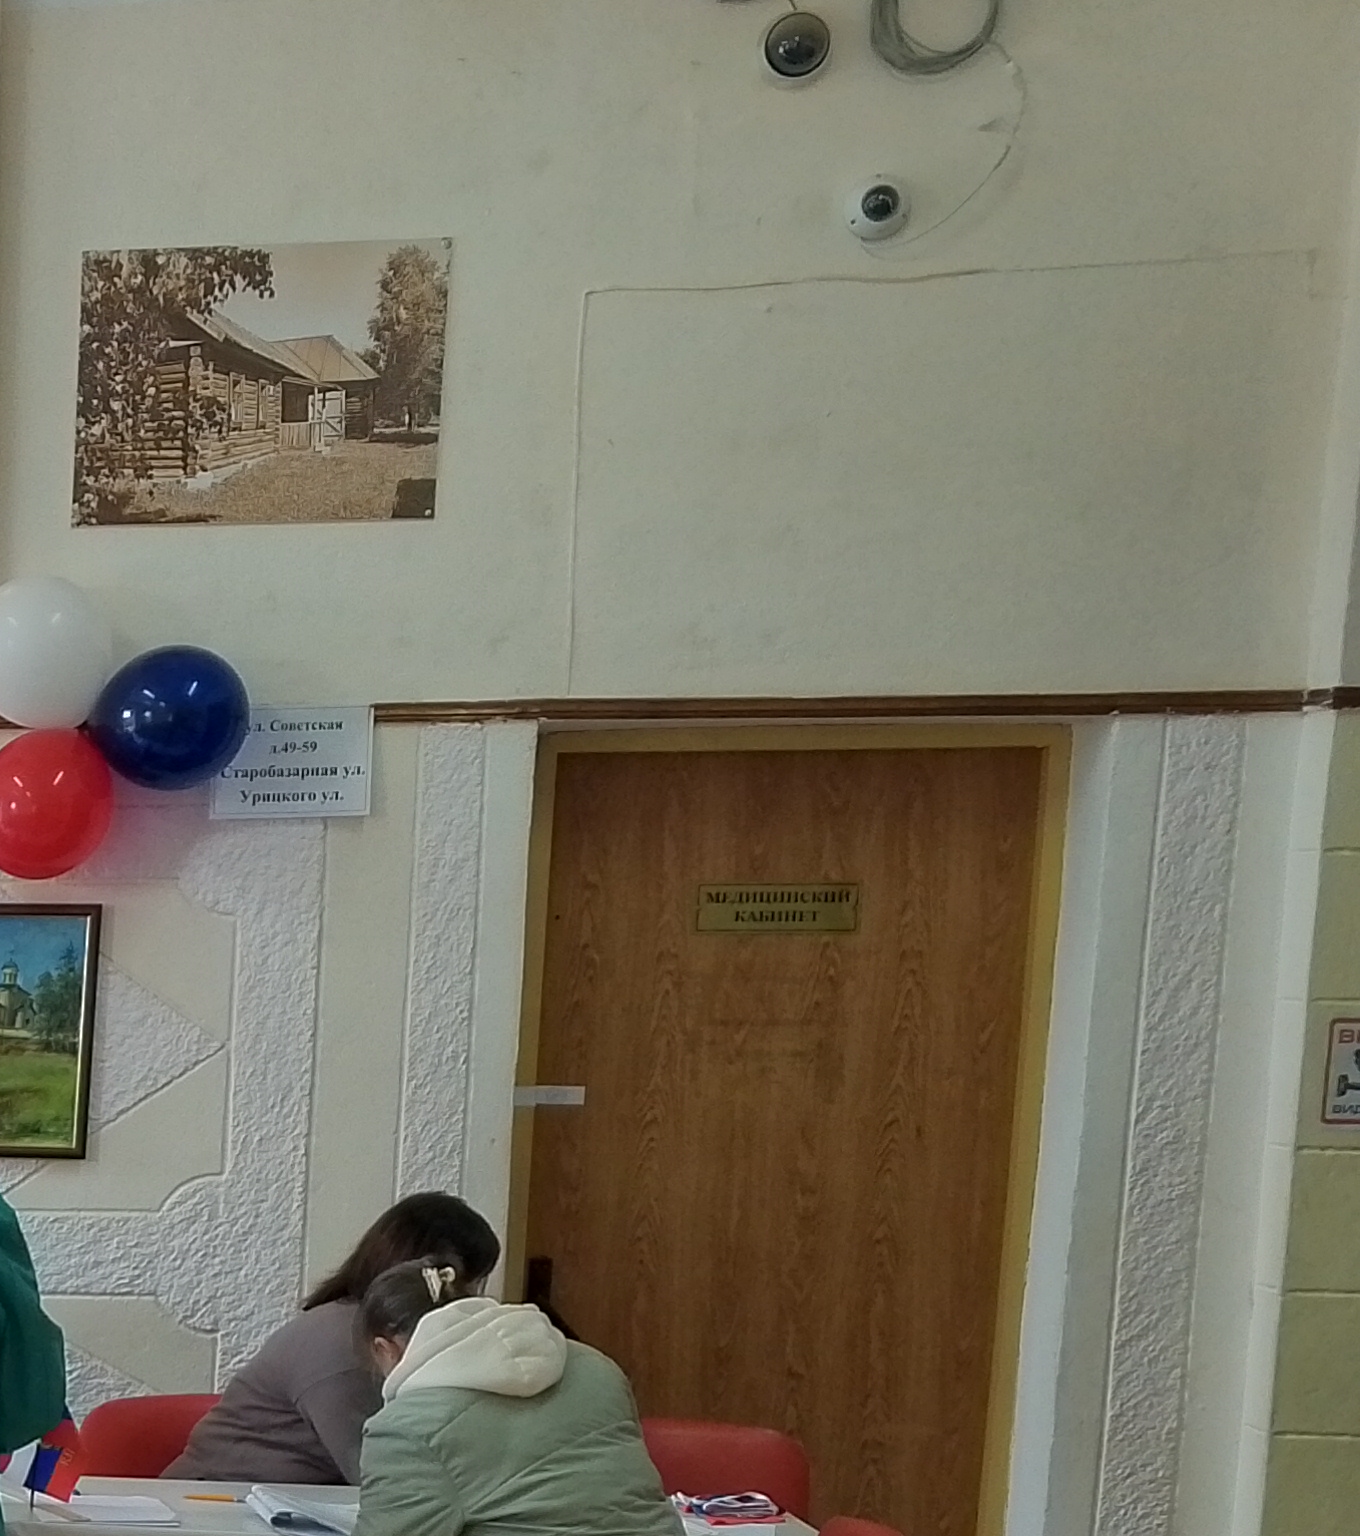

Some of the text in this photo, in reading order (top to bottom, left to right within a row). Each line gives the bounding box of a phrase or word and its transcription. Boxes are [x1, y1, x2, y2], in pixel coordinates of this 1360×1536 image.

[269, 719, 344, 732] Советская
[342, 765, 366, 779] ул.
[239, 789, 344, 806] Урицкого ул.
[706, 888, 852, 904] МЕДИЦИНСКИЙ
[734, 910, 821, 922] КАБИНЕТ
